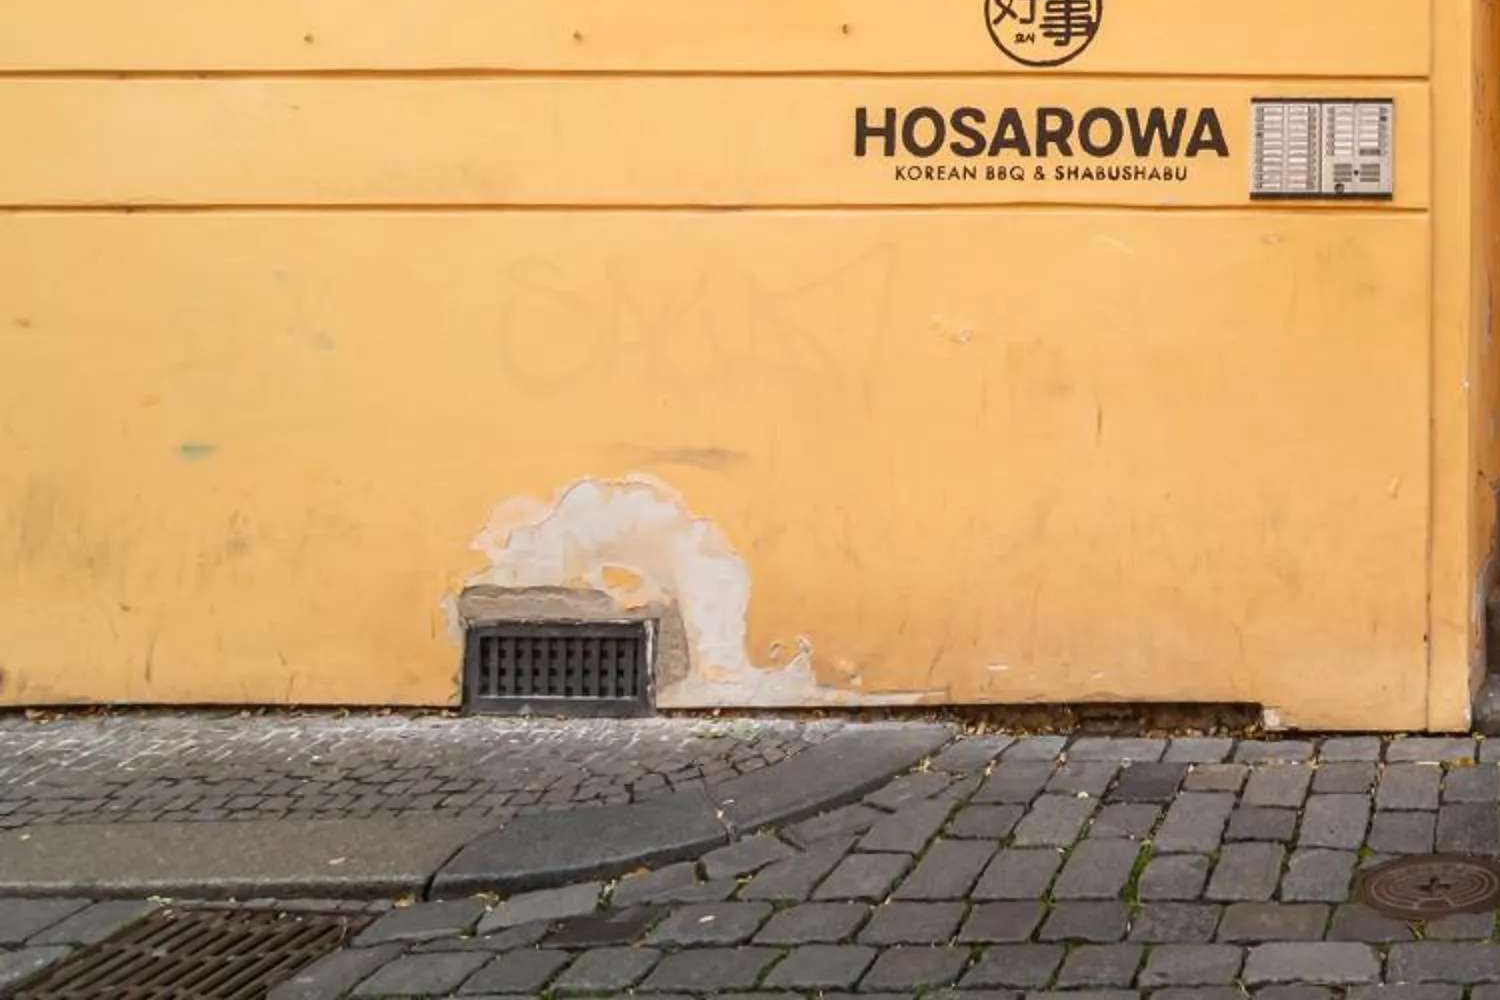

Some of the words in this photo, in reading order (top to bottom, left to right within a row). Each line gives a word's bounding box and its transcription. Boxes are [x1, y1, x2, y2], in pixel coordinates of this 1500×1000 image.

[854, 106, 1230, 158] HOSAROWA
[894, 165, 977, 181] KOREAN
[985, 165, 1025, 181] BBQ
[1033, 165, 1045, 181] &
[1054, 165, 1188, 181] SHABUSHABU
